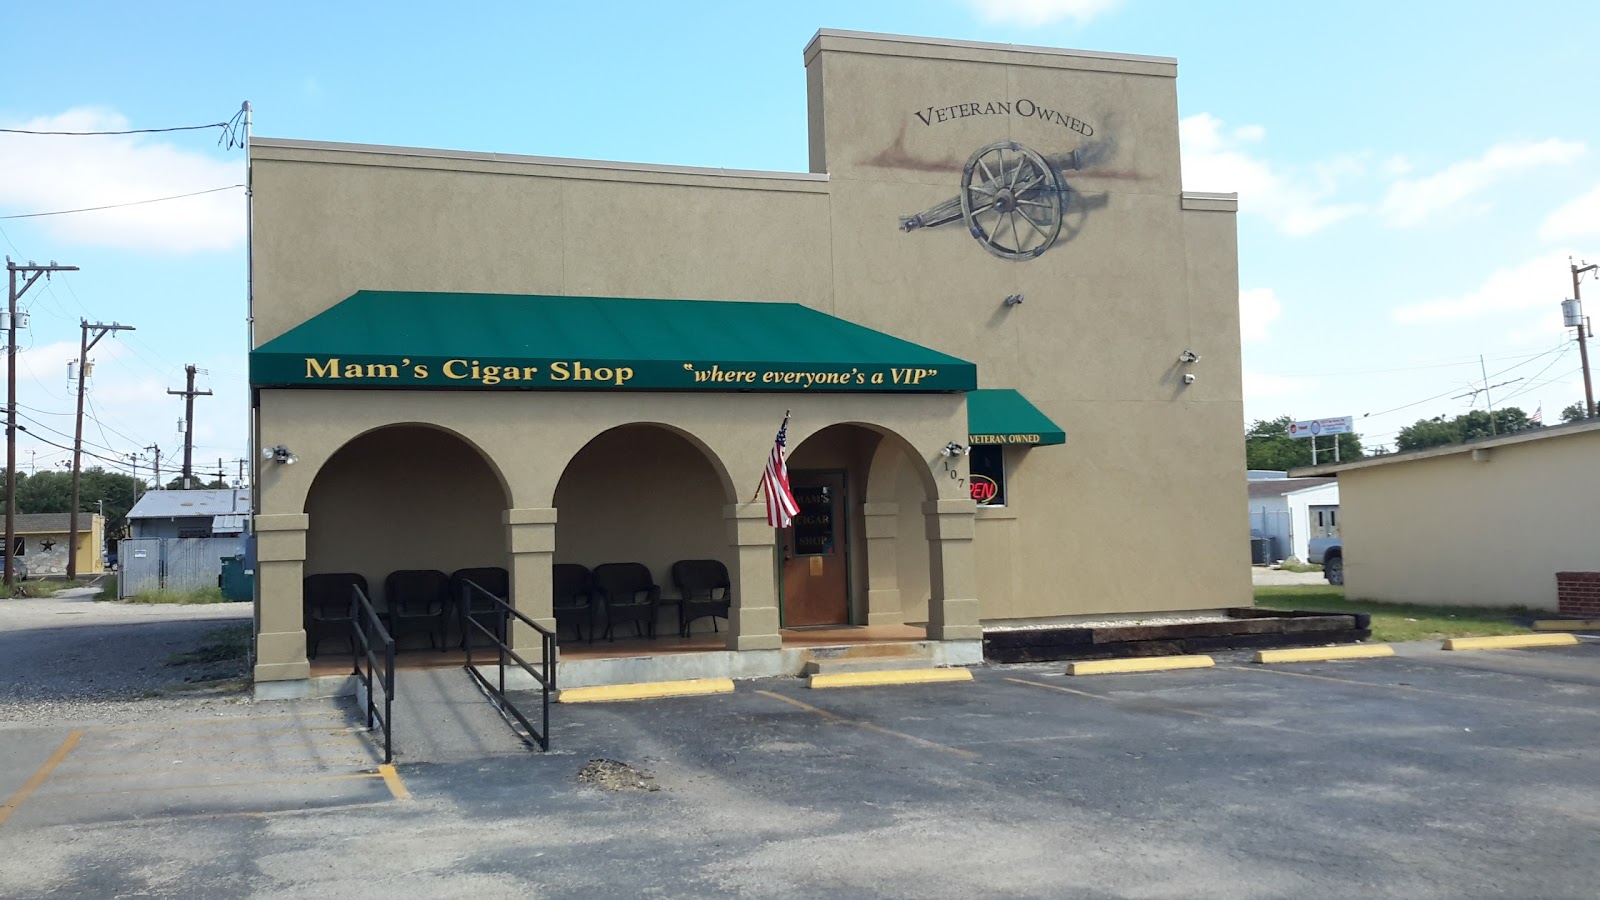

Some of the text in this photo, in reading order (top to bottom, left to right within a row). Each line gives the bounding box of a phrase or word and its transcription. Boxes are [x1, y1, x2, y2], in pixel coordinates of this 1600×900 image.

[914, 98, 1094, 137] VETERAN OWNED
[304, 357, 634, 386] Mam’s Cigar Shop
[683, 363, 938, 388] “where everyone’s a VIP”
[969, 434, 1040, 444] VETERAN OWNED
[969, 482, 994, 499] PEN
[796, 514, 829, 525] CIGAR
[799, 536, 827, 545] SHOP
